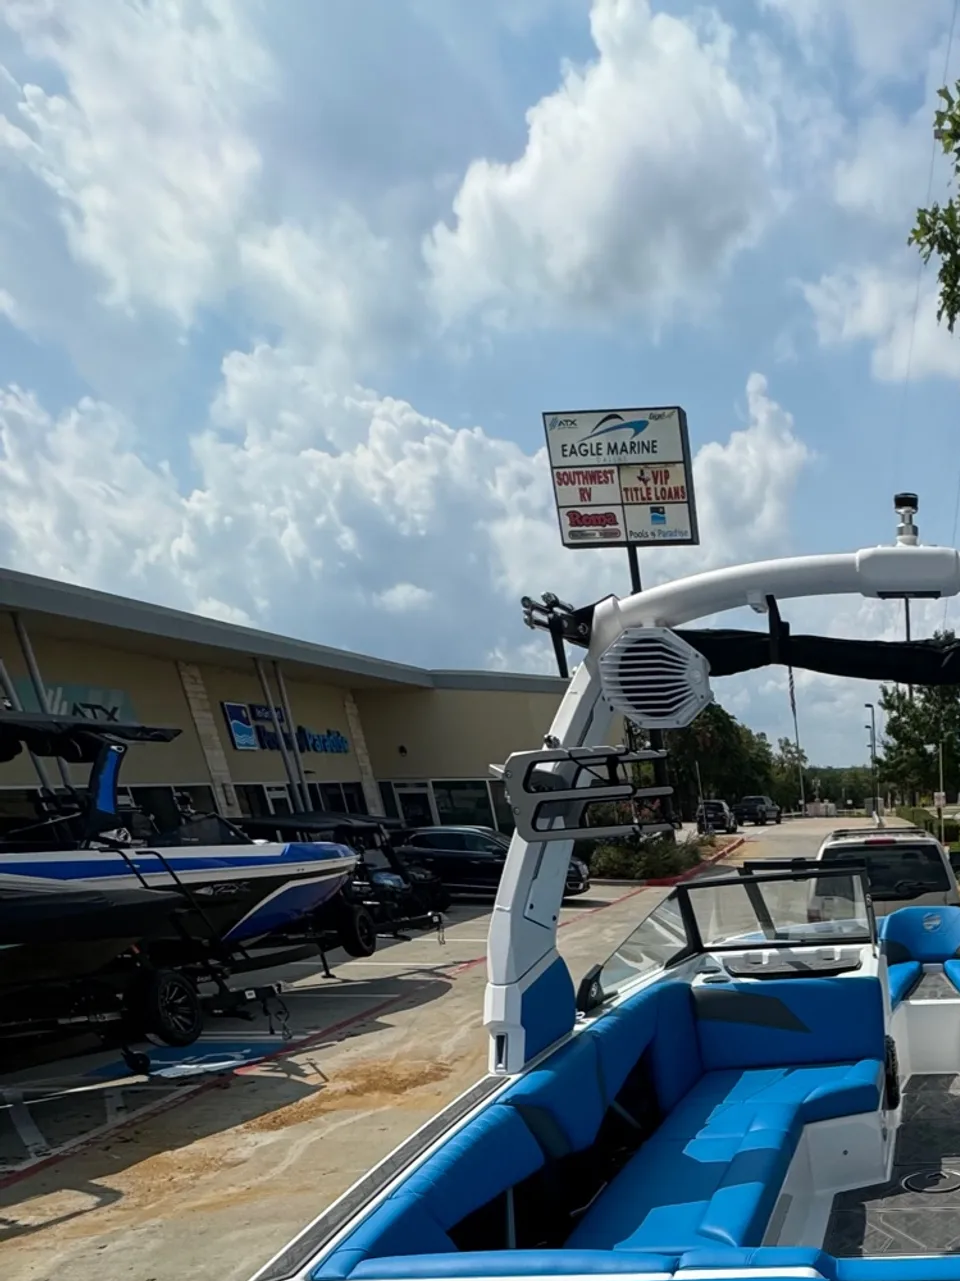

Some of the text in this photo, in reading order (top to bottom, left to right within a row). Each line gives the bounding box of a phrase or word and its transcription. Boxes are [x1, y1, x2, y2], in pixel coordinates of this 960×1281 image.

[557, 418, 577, 427] ATX
[561, 440, 658, 458] EAGLE MARINE
[556, 468, 615, 486] SOUTHWEST
[651, 469, 670, 486] VIP
[579, 487, 592, 502] RV
[623, 485, 686, 501] TITLE LOANS
[629, 529, 649, 538] Pools
[71, 702, 119, 722] ATX
